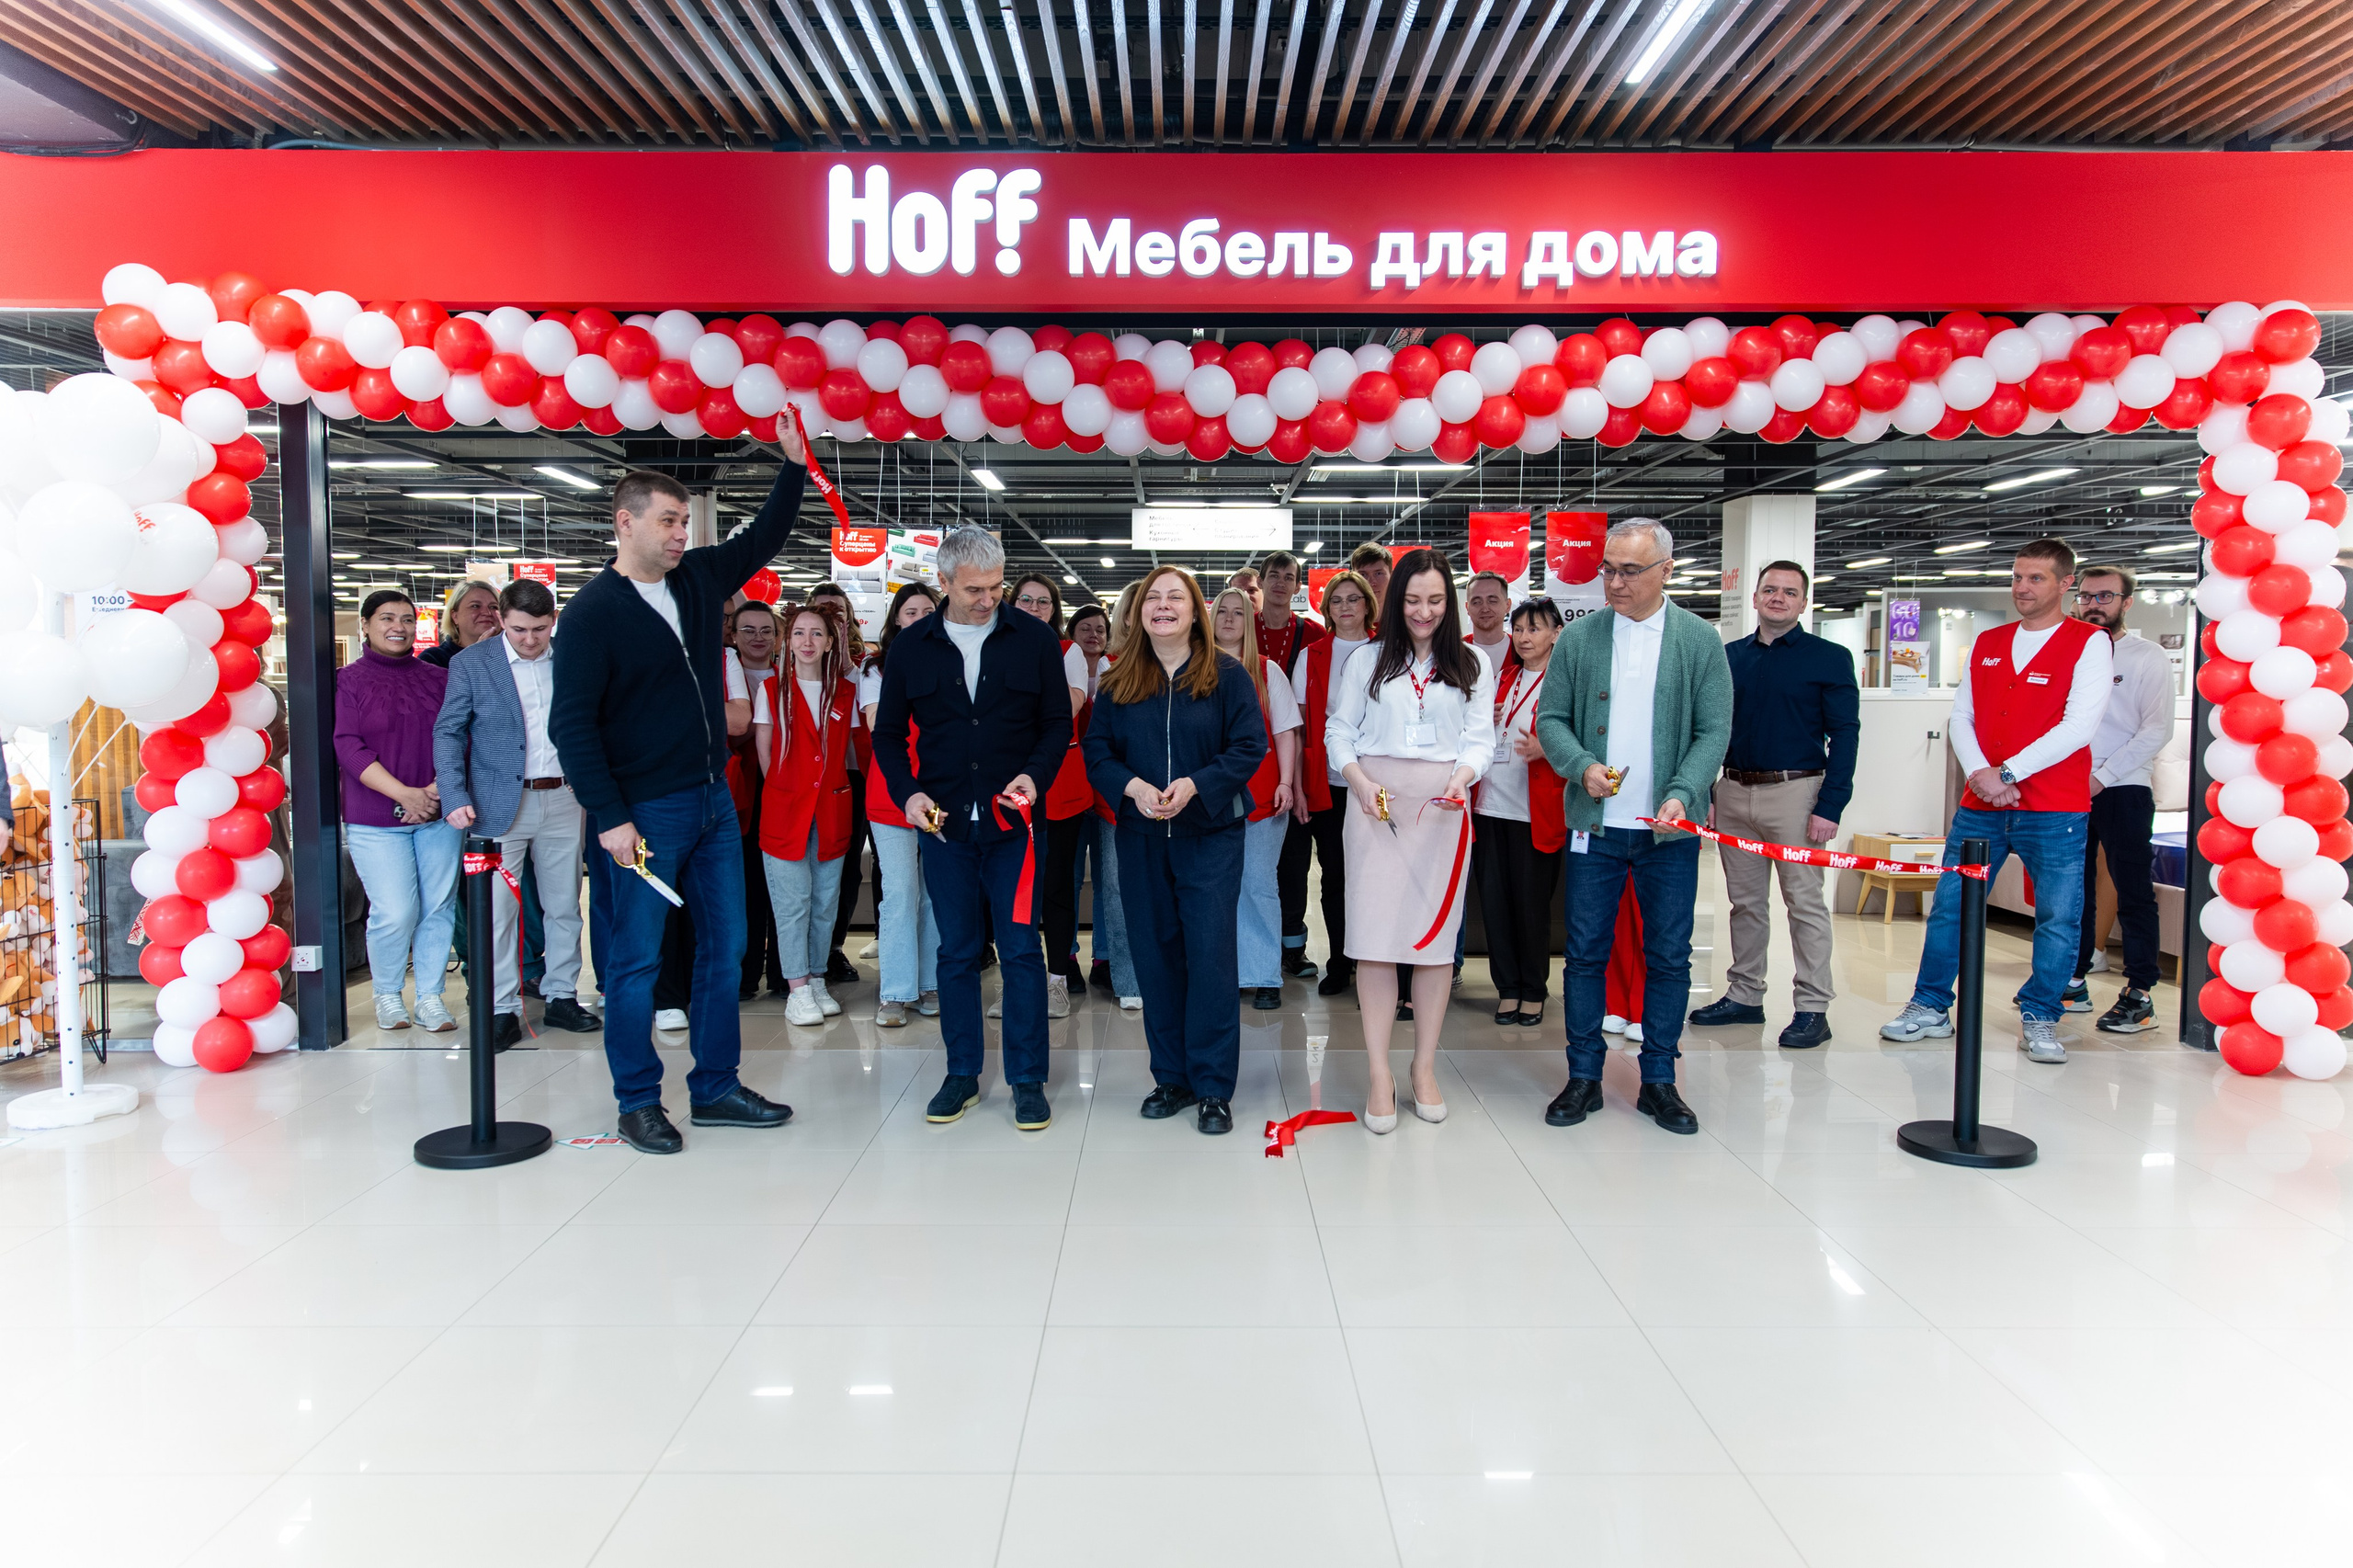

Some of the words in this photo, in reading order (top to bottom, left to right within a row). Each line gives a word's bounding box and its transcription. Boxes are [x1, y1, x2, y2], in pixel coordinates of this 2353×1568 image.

[1068, 217, 1354, 277] Мебель
[1370, 231, 1508, 288] для
[1522, 230, 1719, 288] дома
[1484, 539, 1515, 550] Акция
[1563, 539, 1592, 549] Акция
[1722, 567, 1740, 592] Hoff
[92, 596, 125, 605] 10:00
[1564, 608, 1597, 622] 99
[1982, 657, 2002, 666] Hoff
[1696, 824, 1721, 841] Hoff
[1737, 839, 1764, 854] Hoff
[1783, 846, 1812, 863] Hoff
[1829, 853, 1858, 869] Hoff
[1875, 859, 1904, 872] Hoff
